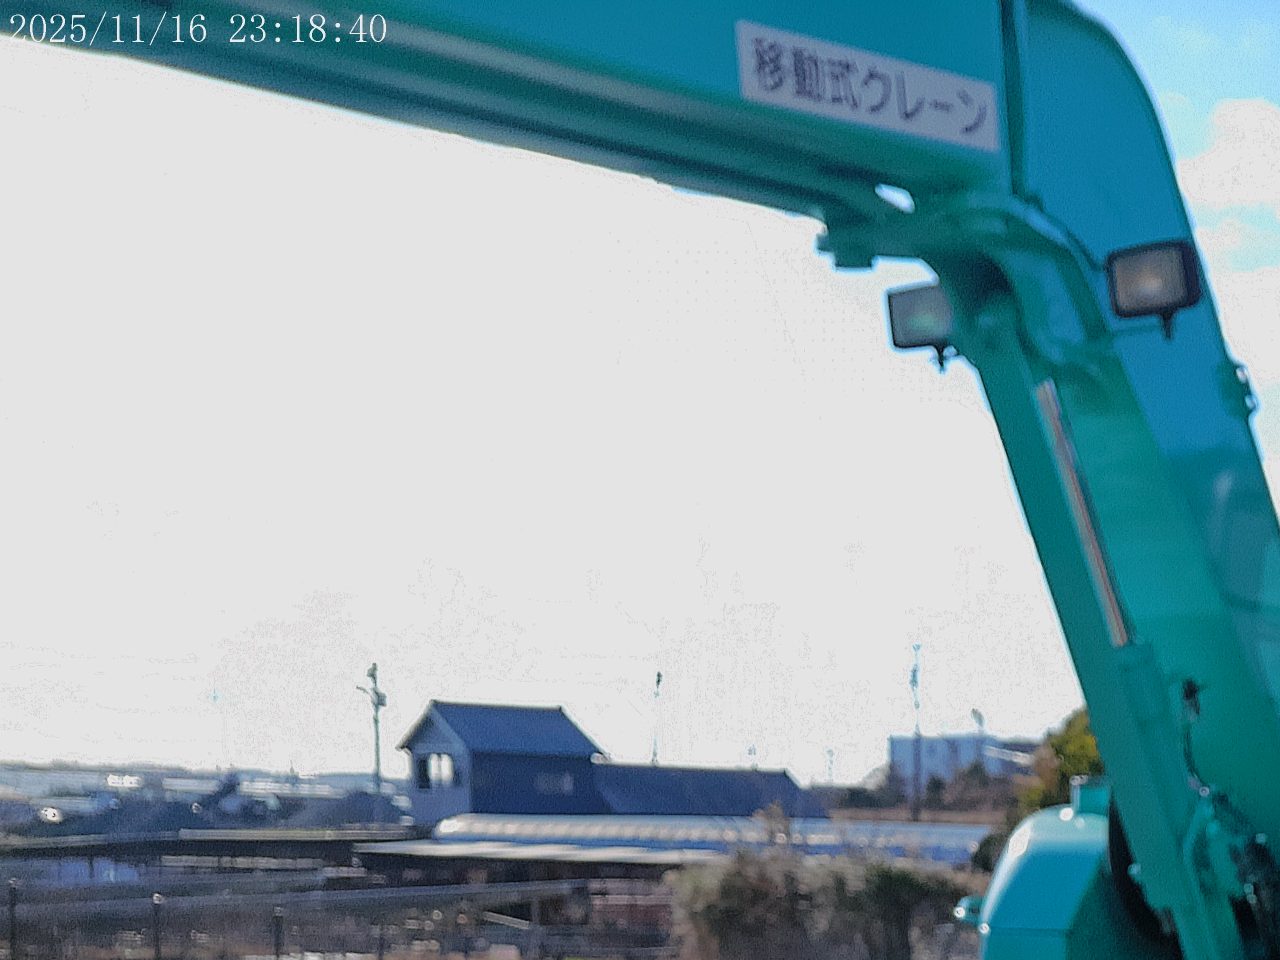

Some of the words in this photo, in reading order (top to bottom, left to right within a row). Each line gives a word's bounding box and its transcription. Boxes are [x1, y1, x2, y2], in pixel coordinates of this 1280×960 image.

[752, 36, 988, 135] 移動式クレーン
